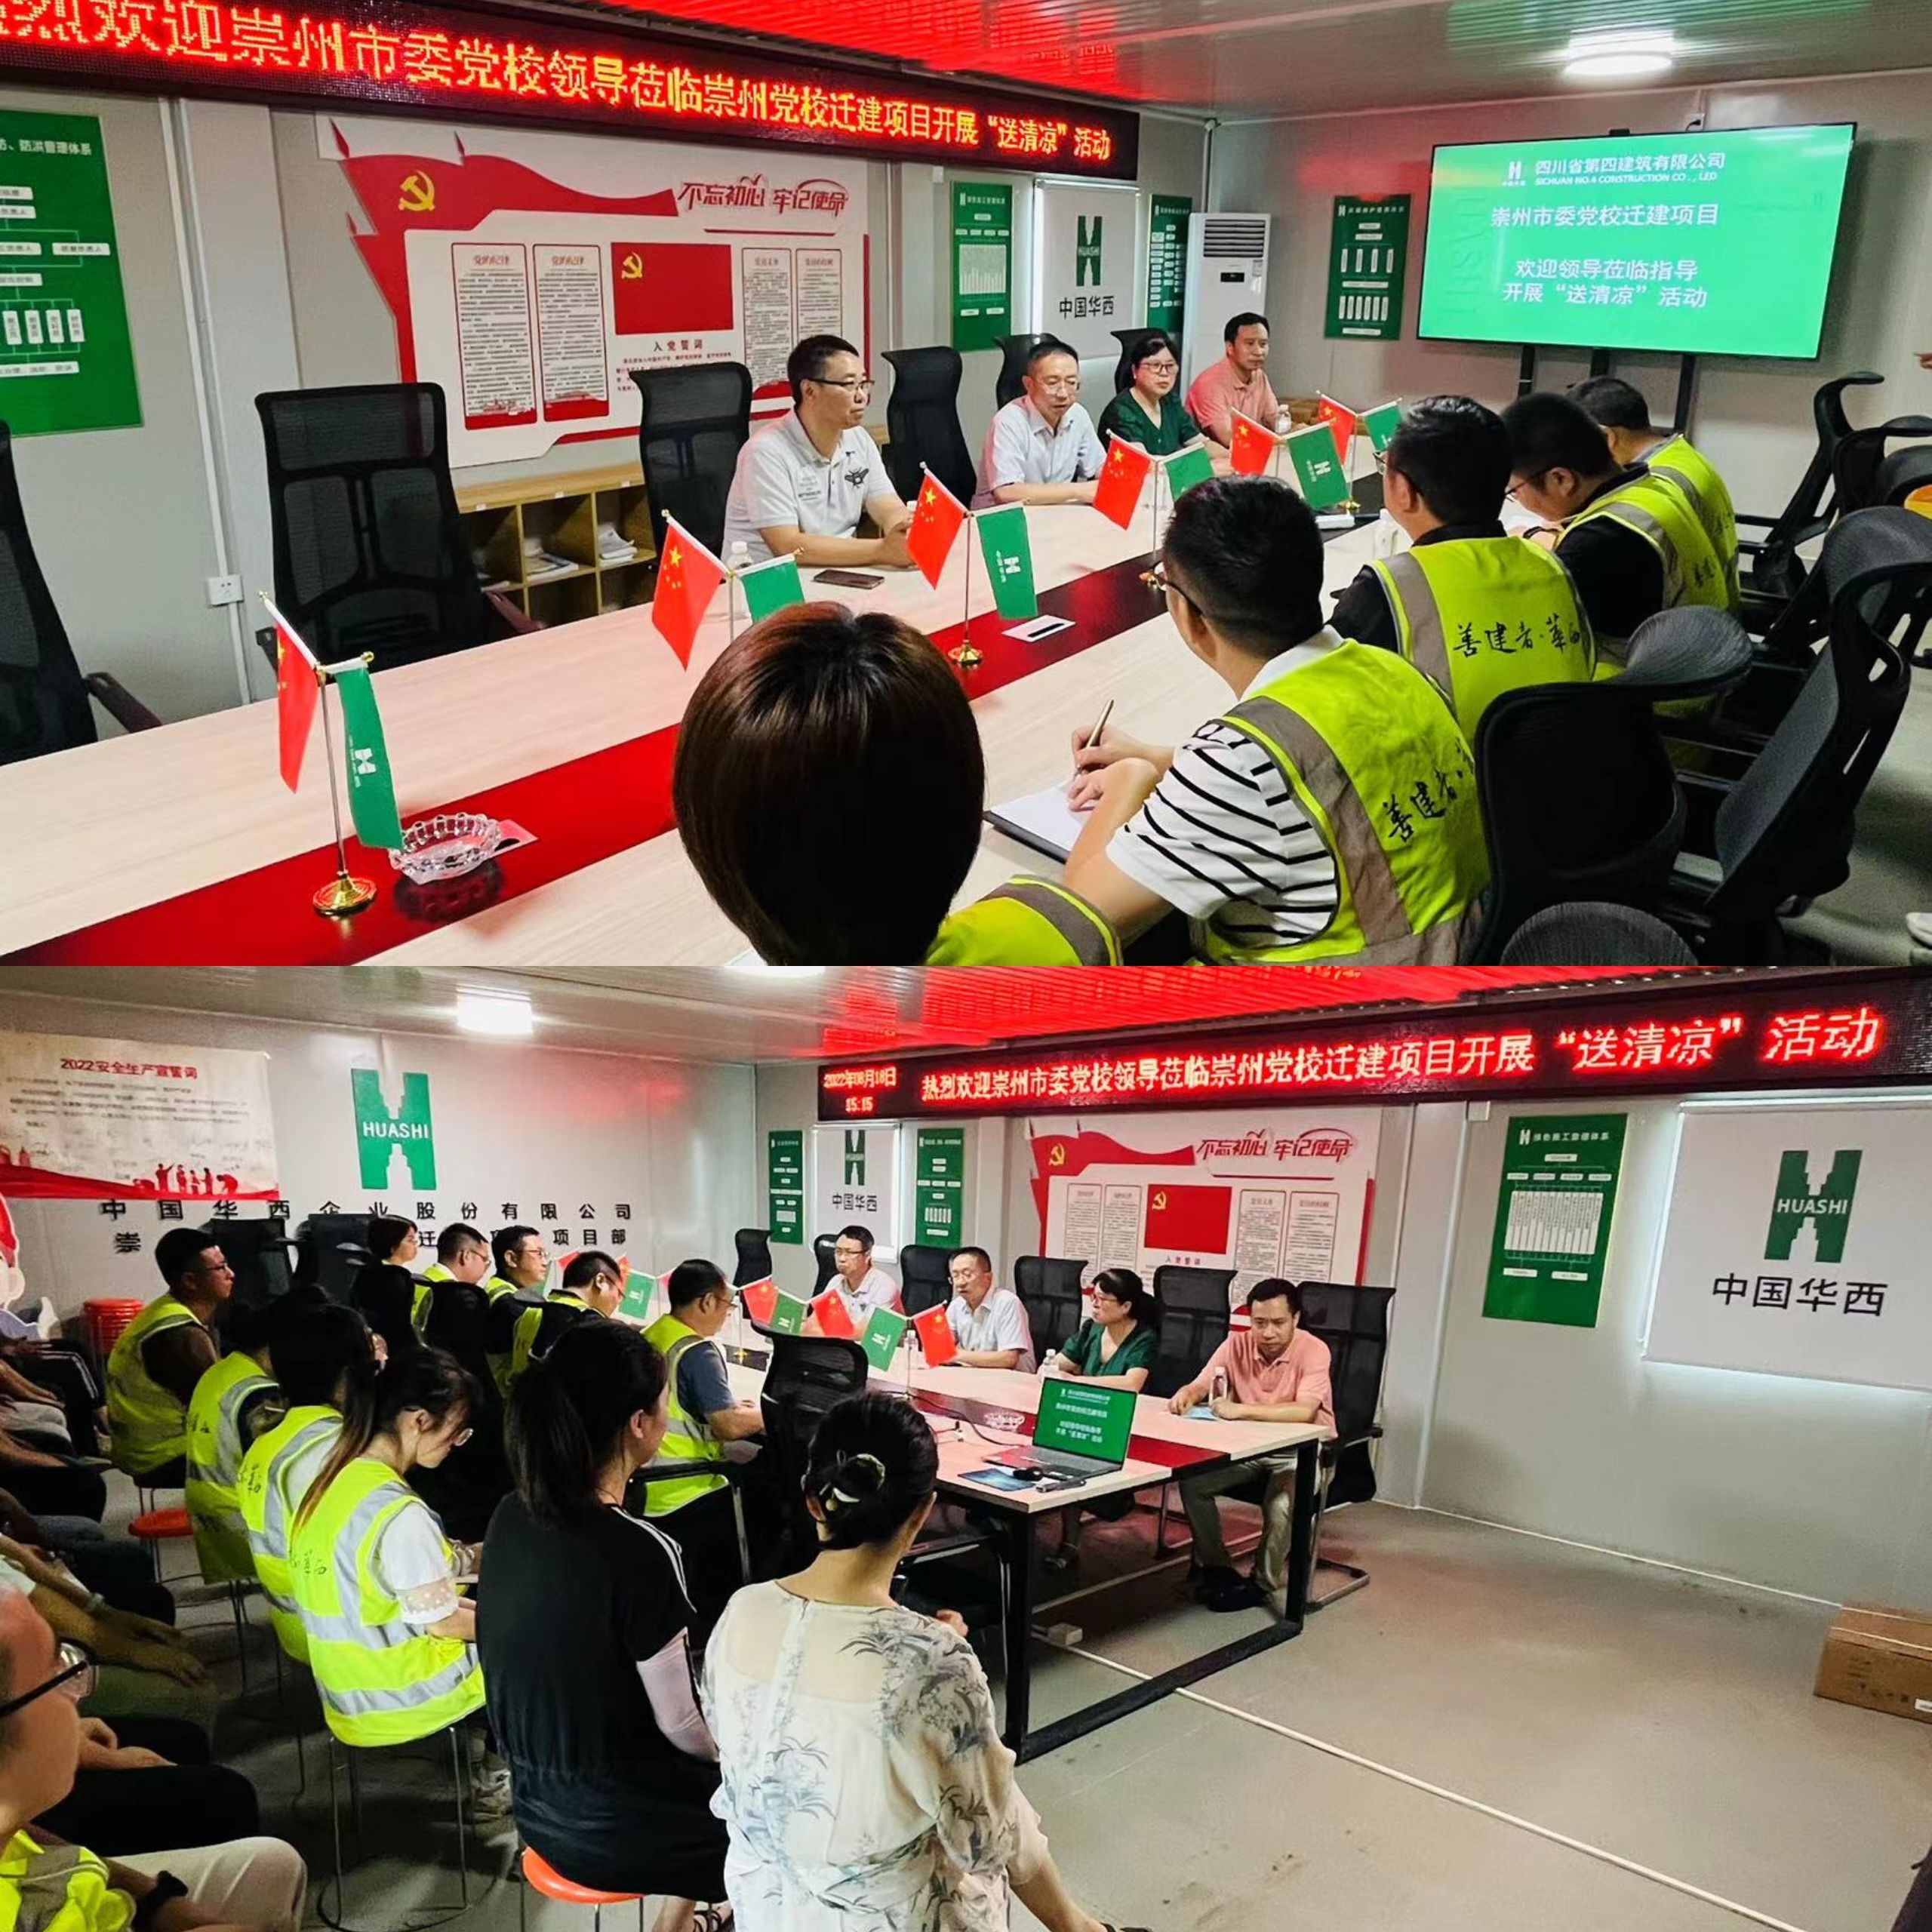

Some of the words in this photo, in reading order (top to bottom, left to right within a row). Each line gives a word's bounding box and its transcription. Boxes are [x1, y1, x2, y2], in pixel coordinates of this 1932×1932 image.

[1535, 152, 1726, 174] 四川省第四建筑有限公司
[1535, 177, 1573, 186] SICHUAN
[1598, 173, 1670, 183] CONSTRUCTION
[678, 175, 765, 210] 不忘初心
[772, 180, 849, 217] 牢记使命
[1491, 203, 1719, 226] 崇州市委党校迁建项目
[1515, 259, 1698, 281] 欢迎领导莅临指导
[1059, 295, 1115, 318] 中国华西
[362, 1121, 429, 1139] HUASHI
[1197, 1129, 1269, 1160] 不忘初心
[1273, 1128, 1353, 1162] 牢记使命
[832, 1192, 877, 1212] 中国华西
[1776, 1197, 1848, 1215] HUASHI
[552, 1229, 627, 1246] 项目部
[1712, 1272, 1888, 1317] 中国华西
